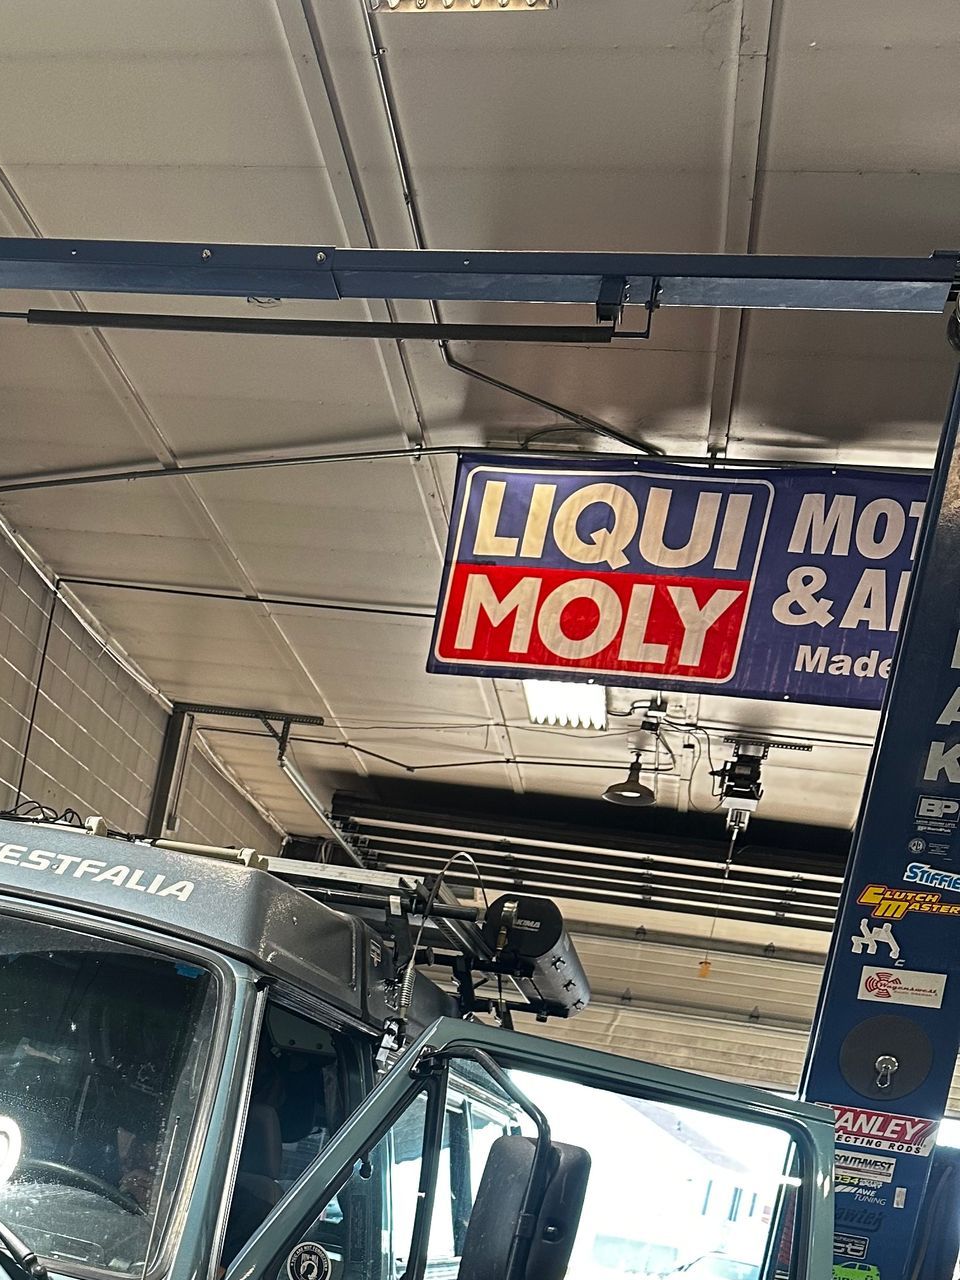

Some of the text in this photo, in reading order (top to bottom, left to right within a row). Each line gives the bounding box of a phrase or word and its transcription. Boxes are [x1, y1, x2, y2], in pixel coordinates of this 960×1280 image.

[473, 480, 754, 570] LIQUI
[772, 566, 835, 628] &
[454, 574, 744, 667] MOLY
[860, 886, 940, 904] CLUTCH
[834, 1109, 925, 1141] ANLEY
[836, 1134, 921, 1154] ECTING RODS
[854, 1193, 887, 1206] TUNING
[856, 1187, 877, 1197] AWE
